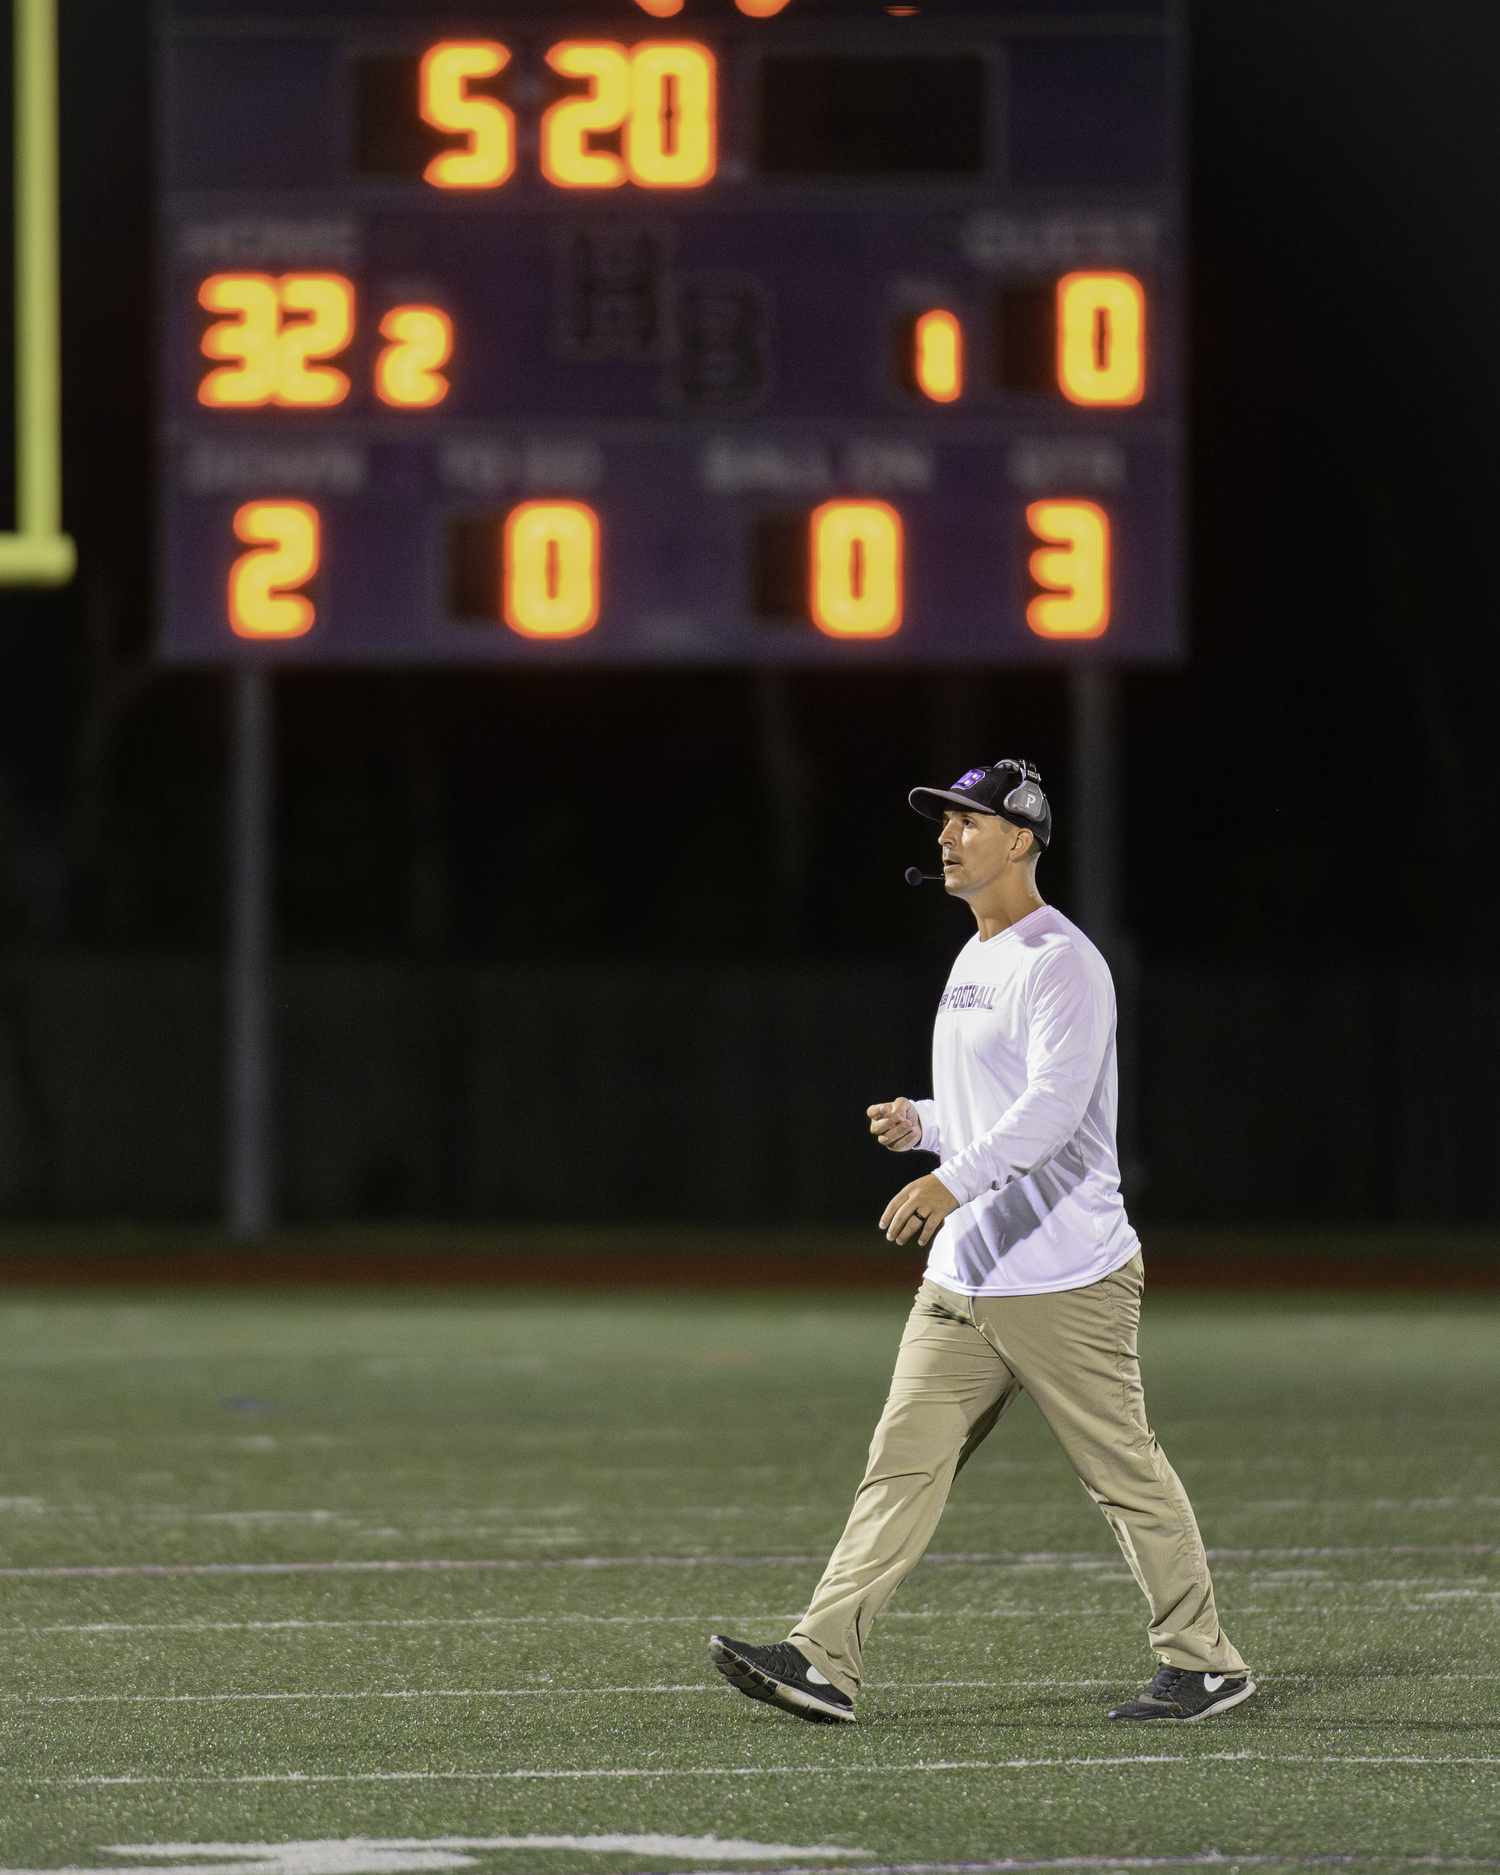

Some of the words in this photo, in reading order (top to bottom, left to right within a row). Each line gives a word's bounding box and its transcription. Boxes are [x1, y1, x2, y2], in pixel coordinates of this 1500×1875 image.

[419, 40, 517, 190] 5
[540, 39, 718, 190] 20
[198, 272, 356, 409] 32
[374, 304, 454, 409] 2
[915, 309, 962, 403] 1
[1056, 270, 1146, 407] 0
[228, 499, 321, 639] 2
[503, 499, 601, 640] 0
[809, 499, 904, 639] 0
[1026, 499, 1111, 639] 3
[1025, 793, 1037, 809] P
[947, 984, 997, 1010] FOOTBALL
